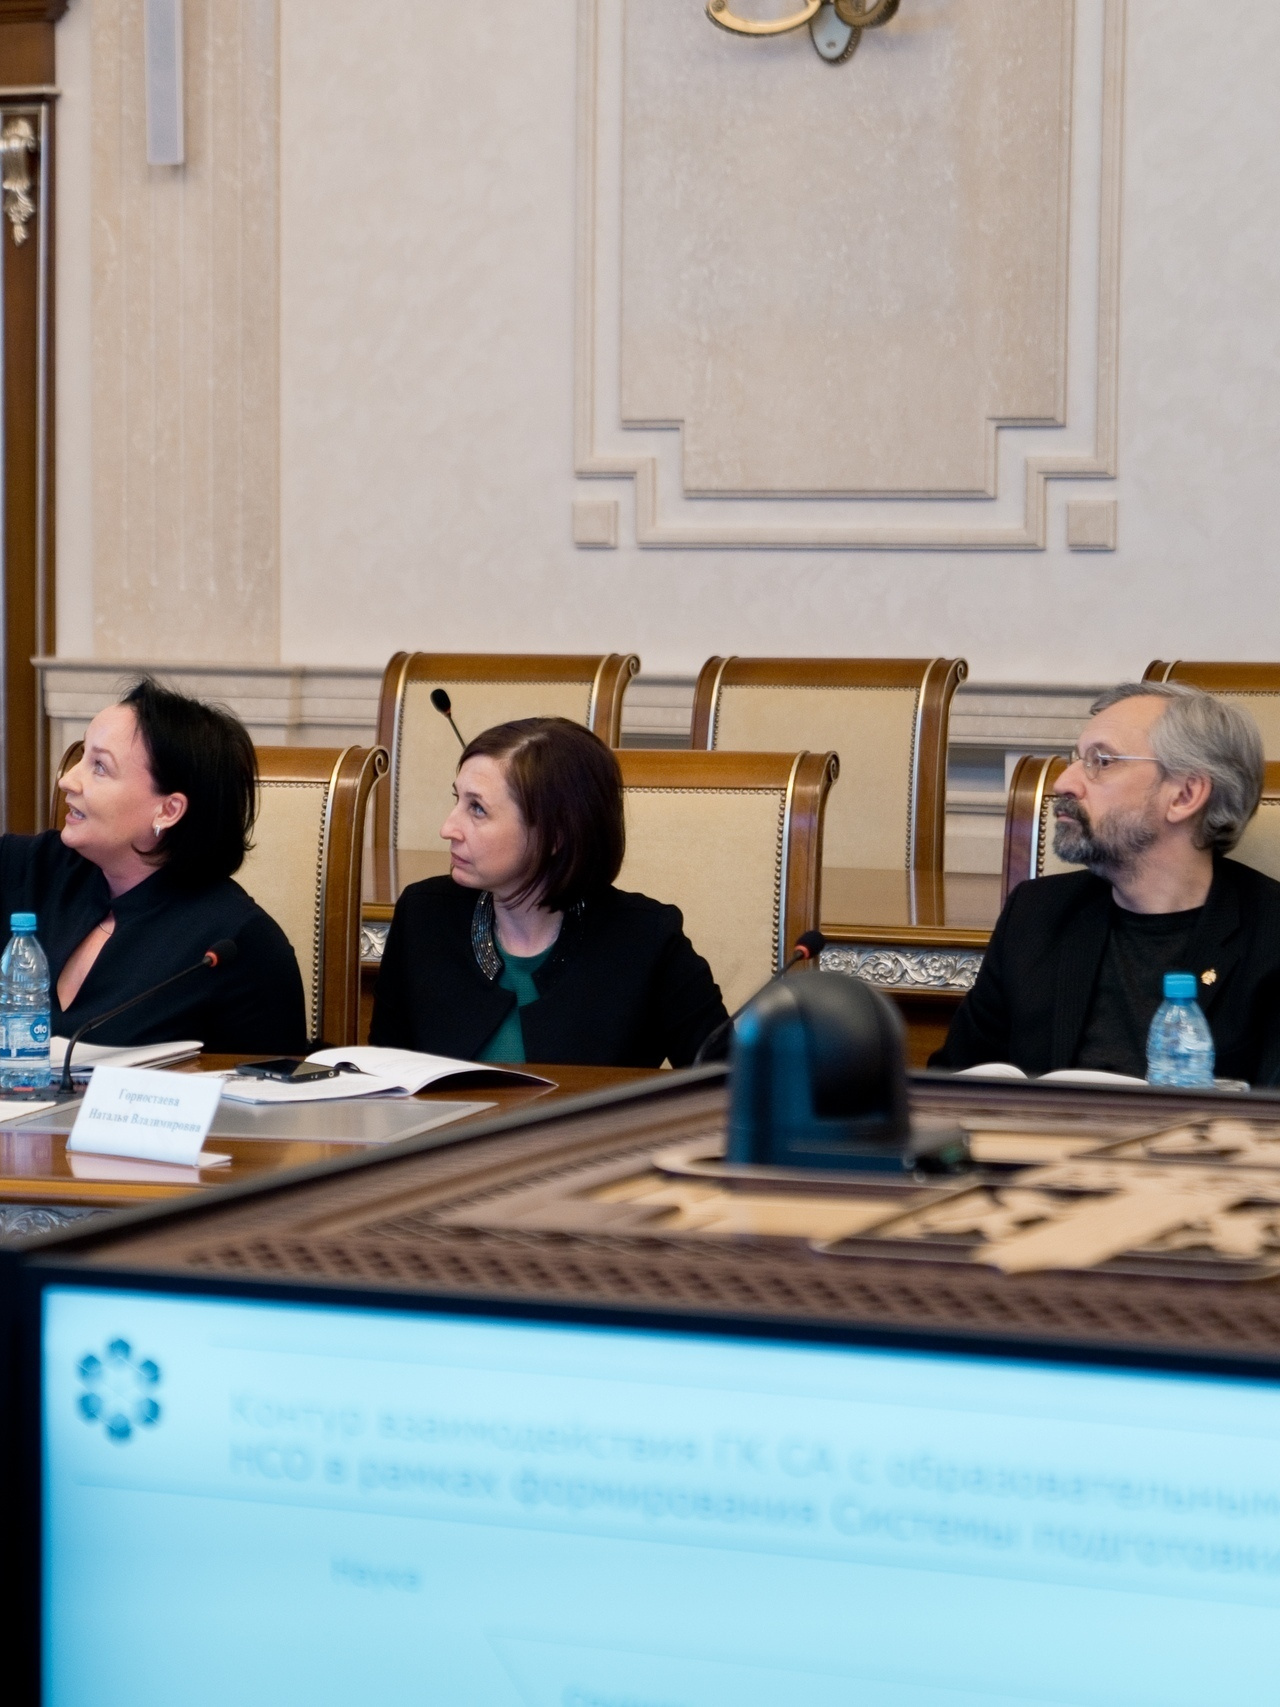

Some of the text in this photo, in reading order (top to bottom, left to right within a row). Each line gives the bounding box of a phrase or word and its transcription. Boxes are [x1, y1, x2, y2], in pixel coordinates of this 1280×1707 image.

[119, 1088, 180, 1106] Горностаева
[89, 1107, 202, 1132] Наталья Владимировна
